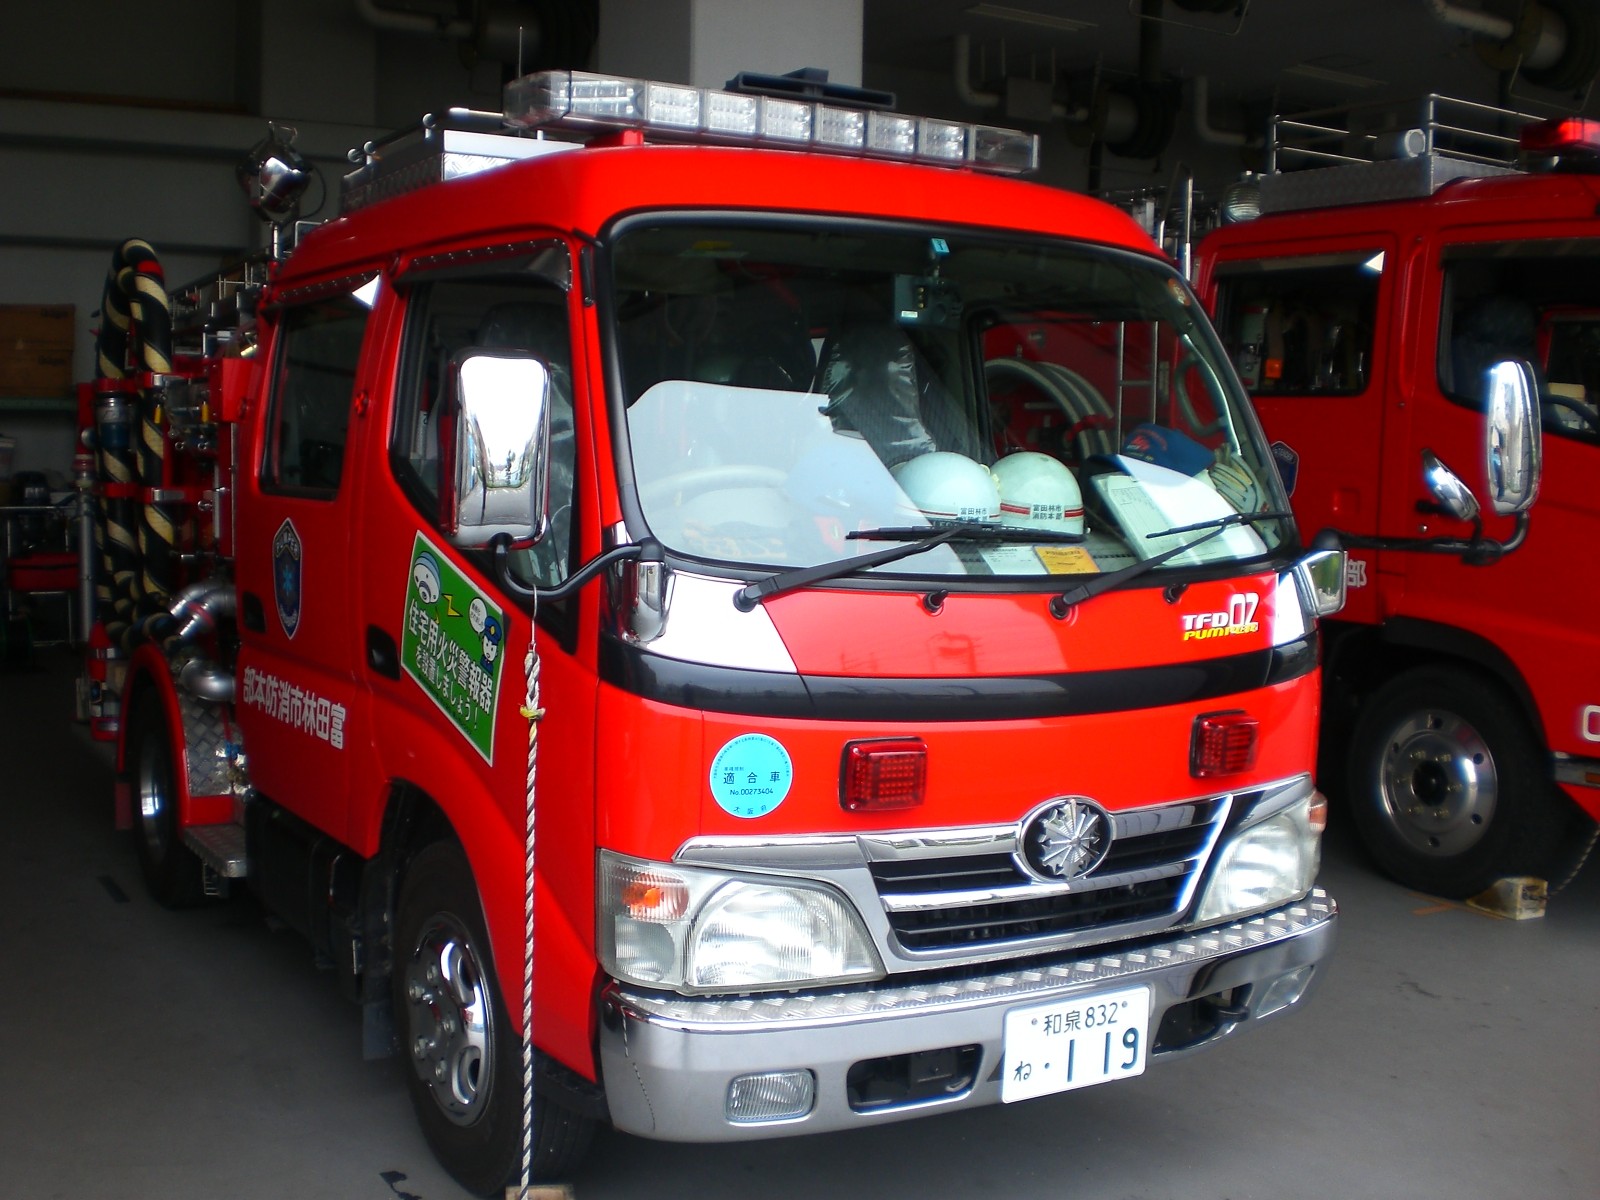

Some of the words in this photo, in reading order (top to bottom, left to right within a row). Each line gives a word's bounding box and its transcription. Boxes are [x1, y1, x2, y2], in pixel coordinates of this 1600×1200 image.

[1032, 504, 1062, 512] 富田林市
[1182, 612, 1229, 631] TFD
[408, 598, 493, 715] 住宅用火災警報器
[723, 771, 781, 785] 適合車
